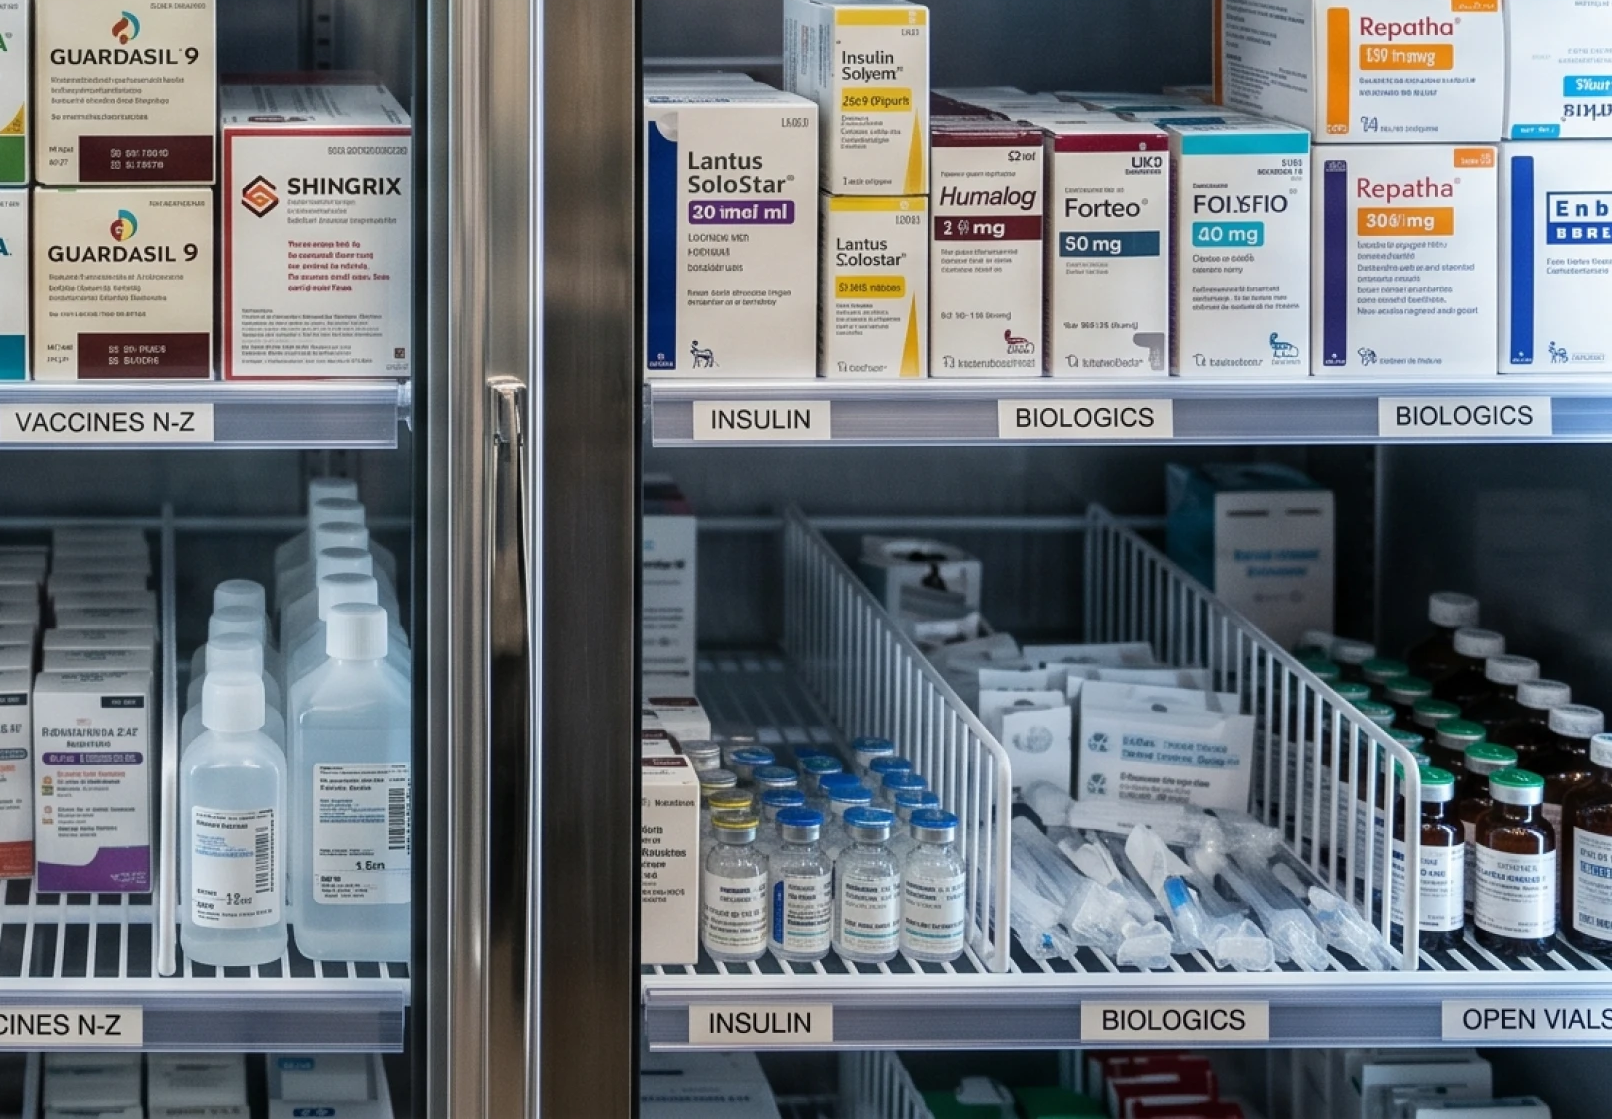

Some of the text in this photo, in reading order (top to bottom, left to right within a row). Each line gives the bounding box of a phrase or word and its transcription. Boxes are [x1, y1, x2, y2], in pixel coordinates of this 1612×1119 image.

[1359, 16, 1455, 41] Repatha
[50, 46, 200, 66] GUARDASIL 9
[841, 50, 894, 65] Insulin
[688, 150, 764, 171] Lantus
[287, 177, 402, 196] SHINGRIX
[687, 174, 786, 194] SoloStar
[1356, 177, 1455, 204] Repatha
[939, 185, 1037, 211] Humalog
[1064, 197, 1141, 218] Forteo
[972, 220, 1006, 239] mg
[1228, 227, 1259, 245] mg
[47, 242, 199, 264] GUARDASIL 9
[836, 237, 888, 251] Lantus
[1092, 238, 1122, 255] mg
[15, 412, 196, 432] VACCINES N-Z
[711, 409, 811, 430] INSULIN
[1016, 407, 1155, 428] BIOLOGICS
[1396, 405, 1534, 426] BIOLOGICS
[77, 1013, 122, 1035] N-Z
[708, 1012, 812, 1034] INSULIN
[1101, 1009, 1246, 1031] BIOLOGICS
[1462, 1008, 1612, 1030] OPEN VIALS
